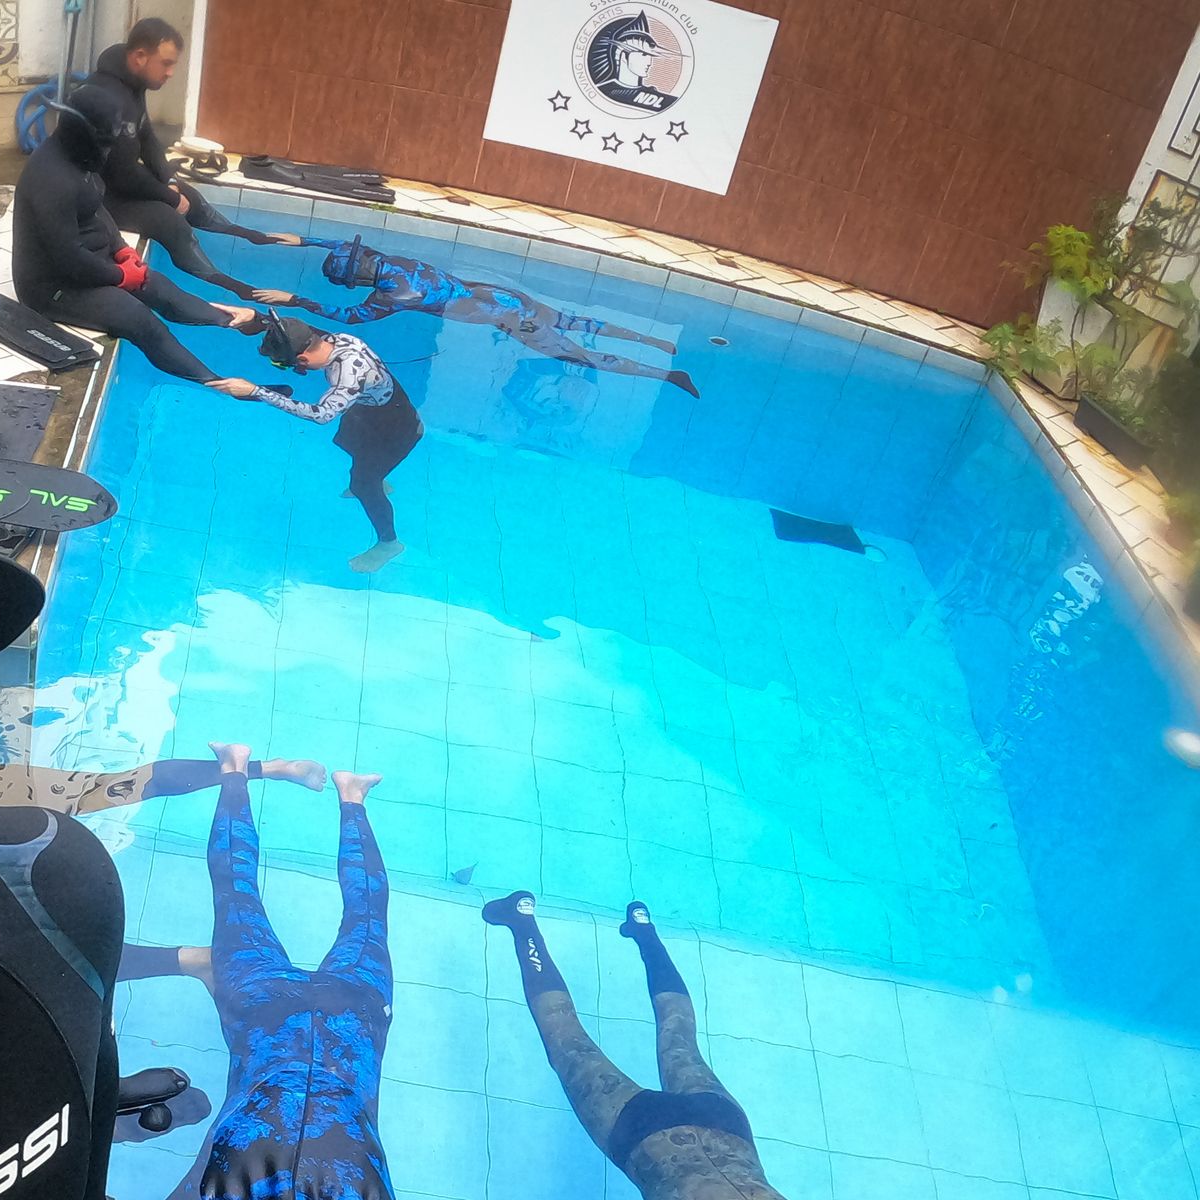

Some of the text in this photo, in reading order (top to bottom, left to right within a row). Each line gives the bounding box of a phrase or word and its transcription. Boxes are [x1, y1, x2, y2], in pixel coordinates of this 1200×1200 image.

[680, 13, 699, 35] club
[575, 6, 623, 100] DIVING LEGE ARTIS
[633, 91, 664, 108] NDL
